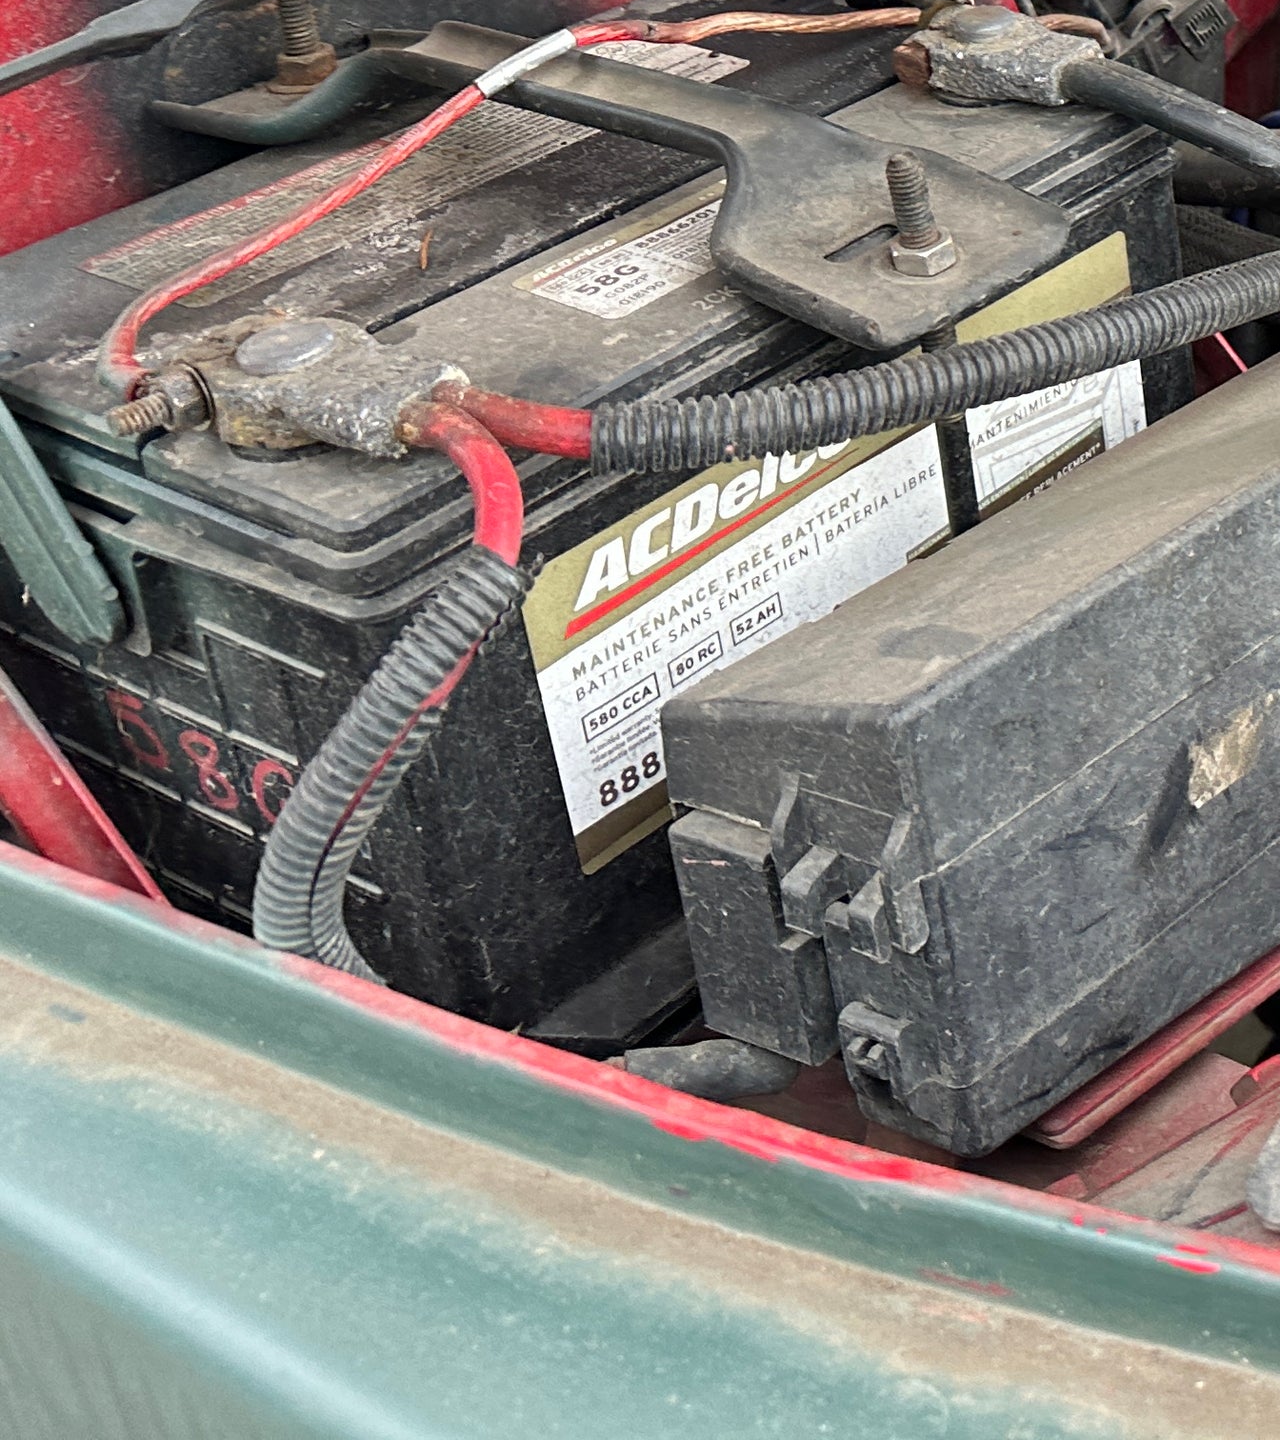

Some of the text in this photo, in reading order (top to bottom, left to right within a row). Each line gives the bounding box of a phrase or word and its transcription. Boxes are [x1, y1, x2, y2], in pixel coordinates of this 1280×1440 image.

[575, 264, 640, 296] 58G
[572, 579, 720, 681] MAINTENANCE
[726, 544, 775, 584] FREE
[781, 488, 861, 548] BATTERY
[575, 642, 662, 702] BATTERIE
[669, 607, 712, 643] SANS
[718, 544, 810, 612] ENTRETIEN
[894, 463, 937, 499] LIBRE
[735, 602, 777, 636] 52 AH
[676, 642, 717, 676] 80 RC
[589, 685, 652, 732] 580 CCA
[599, 751, 661, 807] 888
